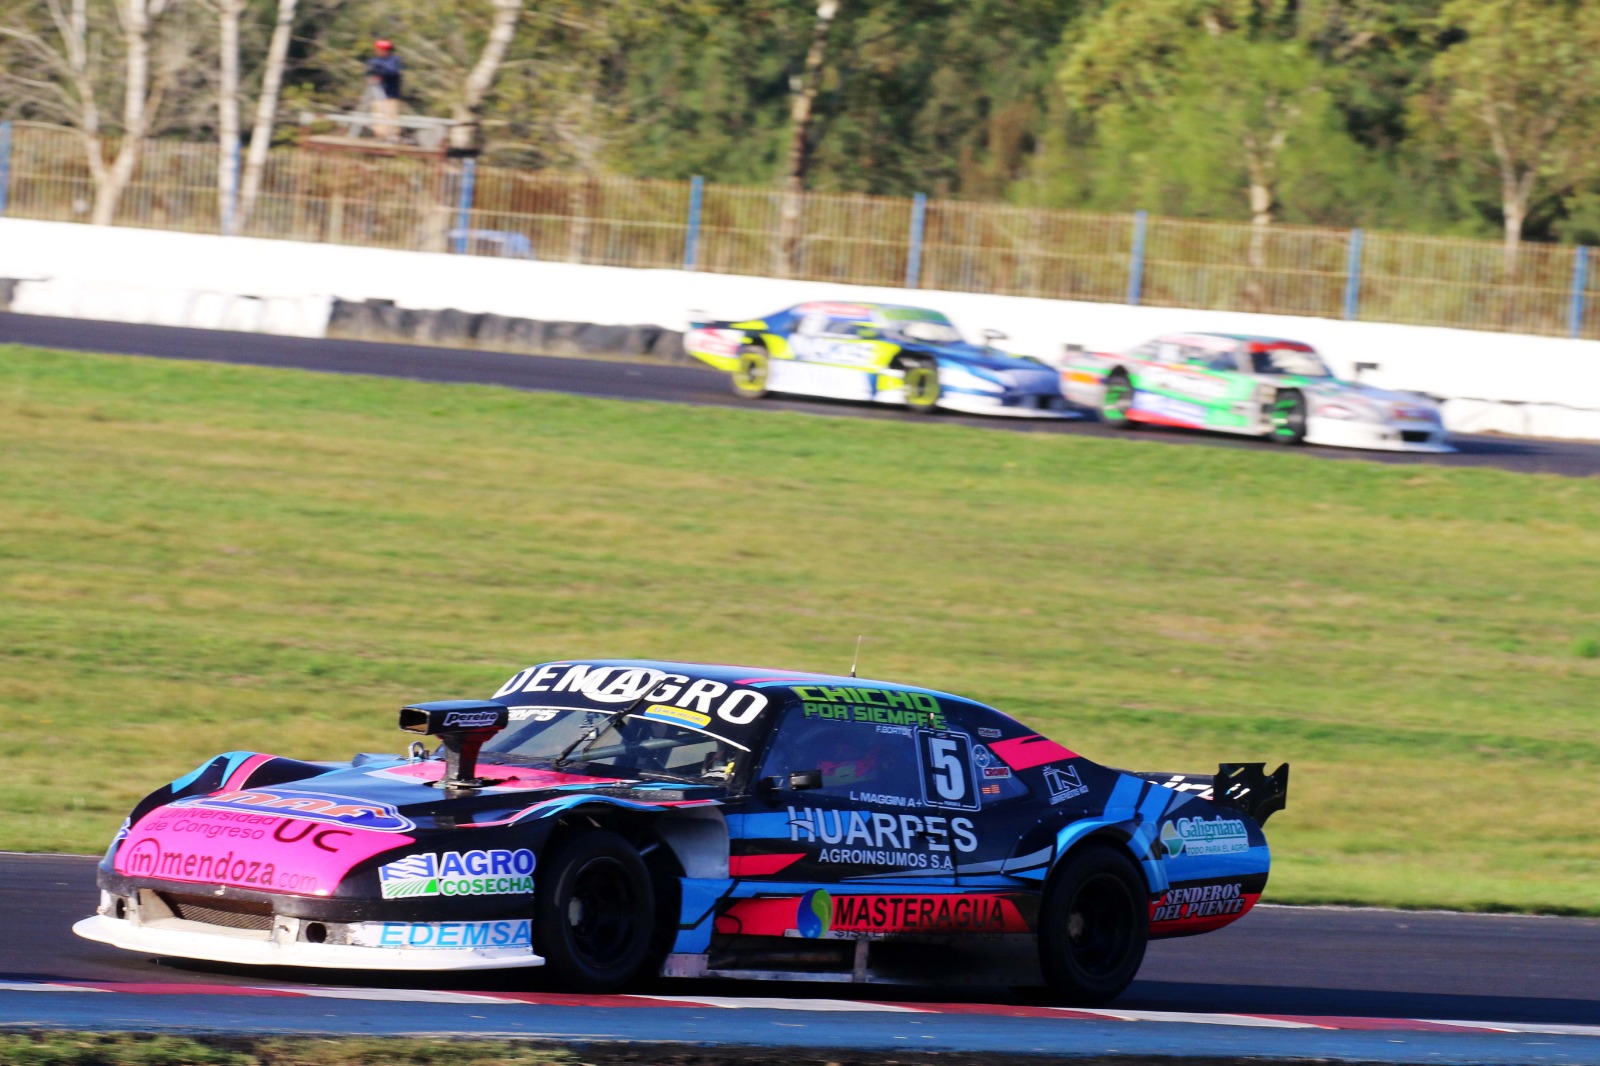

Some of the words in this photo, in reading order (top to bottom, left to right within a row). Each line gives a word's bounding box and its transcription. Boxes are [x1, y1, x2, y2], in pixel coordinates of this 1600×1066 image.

[491, 663, 768, 725] DEMAGRO
[790, 686, 942, 713] CHICHO
[803, 702, 849, 720] POR
[853, 706, 948, 730] SIEMPRE
[930, 738, 965, 800] 5
[860, 792, 906, 808] MAGGINI
[145, 818, 167, 831] de
[173, 819, 265, 838] Congreso
[159, 807, 278, 825] Universidad
[273, 818, 352, 853] UC
[787, 806, 978, 852] HUARPES
[1180, 818, 1245, 842] Galigniana
[819, 848, 928, 868] AGROINSUMOS
[1205, 845, 1221, 853] PARA
[1222, 845, 1230, 853] EL
[443, 850, 534, 876] AGRO
[443, 877, 534, 895] COSECHA
[1165, 883, 1242, 906] SENDEROS
[834, 897, 1005, 927] MASTERAGUA
[1152, 903, 1184, 922] DEL
[1185, 898, 1245, 919] PUENTE
[380, 921, 531, 946] EDEMSA
